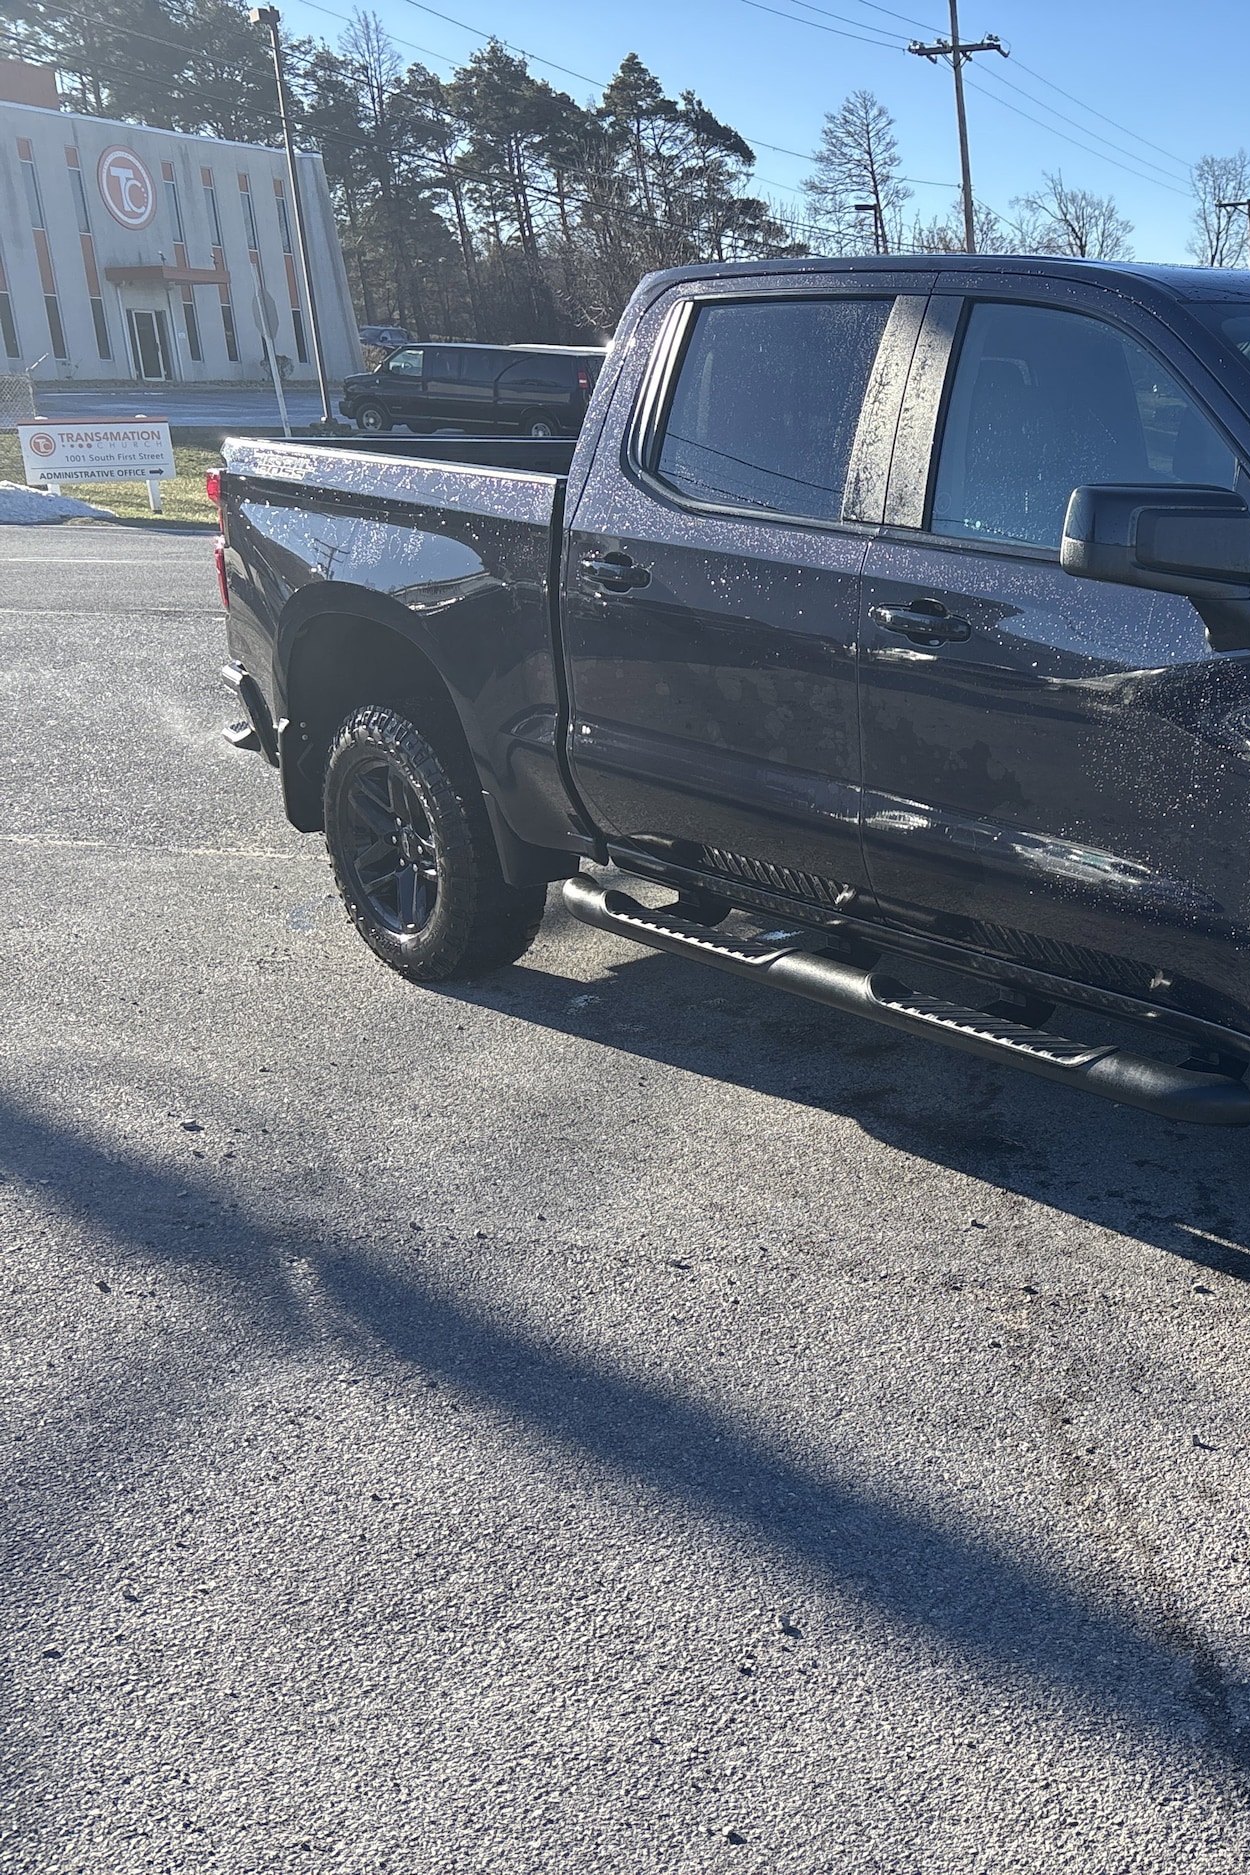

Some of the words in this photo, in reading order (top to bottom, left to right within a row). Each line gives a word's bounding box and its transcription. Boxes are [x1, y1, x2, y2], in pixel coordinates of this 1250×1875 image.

[57, 430, 161, 443] TRANS4MATION
[97, 441, 163, 449] CHURCH
[65, 454, 86, 462] 1001
[89, 453, 115, 462] South
[117, 453, 136, 461] First
[138, 452, 164, 461] Street
[39, 469, 115, 480] ADMINISTRATIVE
[116, 468, 146, 477] OFFICE
[257, 465, 305, 480] BOSS
